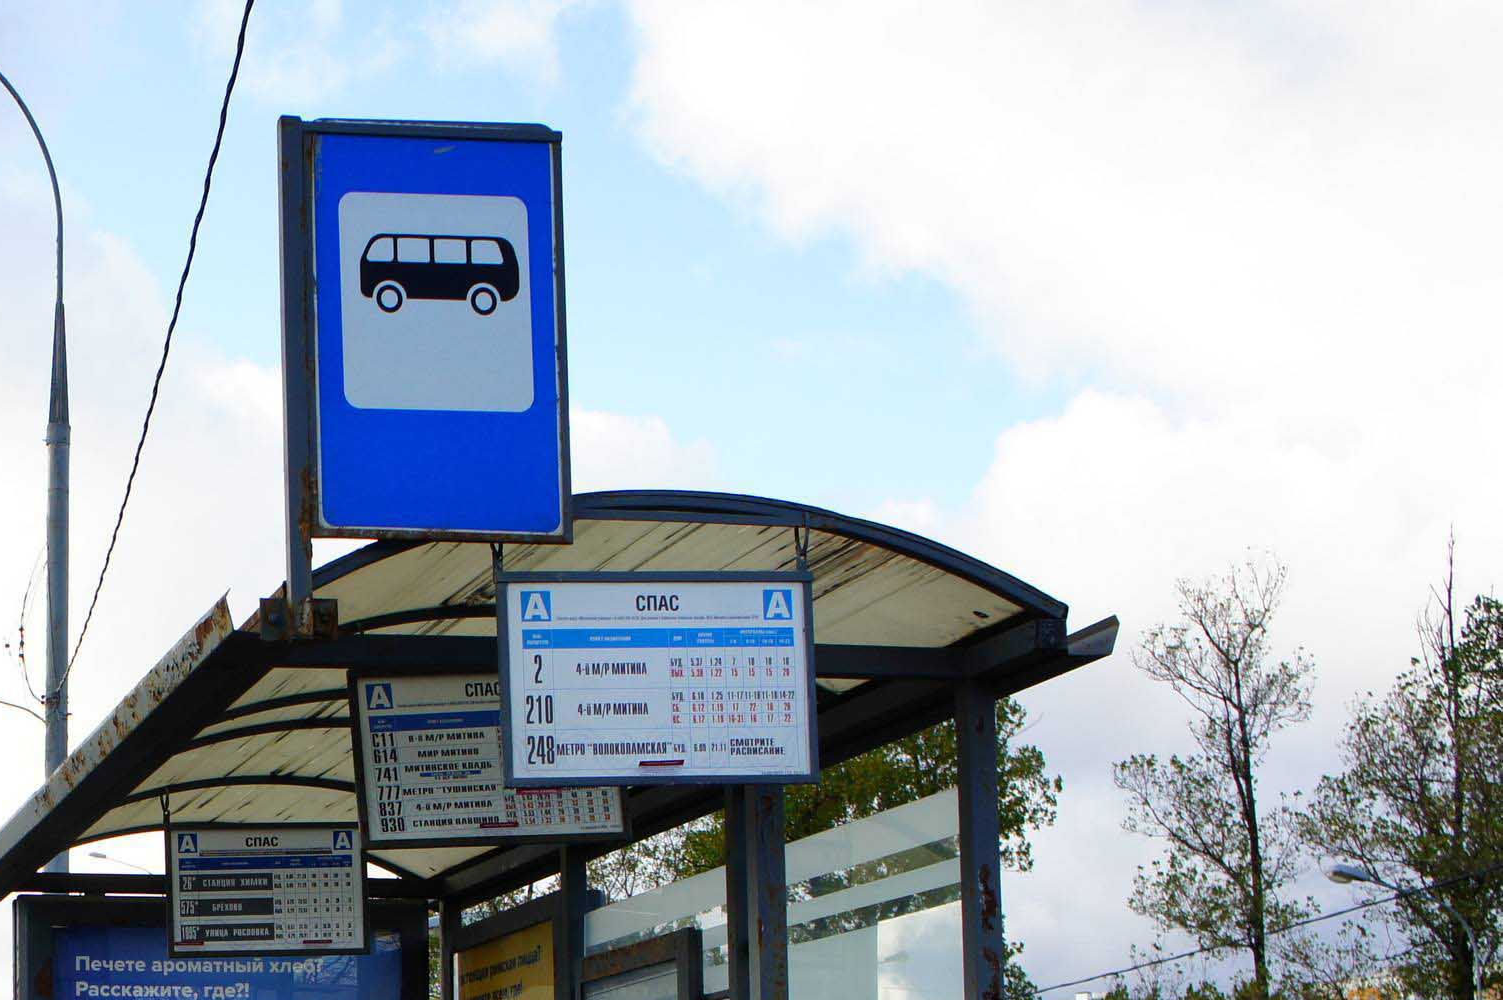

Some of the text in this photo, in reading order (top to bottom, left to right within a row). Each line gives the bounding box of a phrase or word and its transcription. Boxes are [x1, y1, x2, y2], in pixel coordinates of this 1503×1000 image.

[635, 595, 680, 612] СПАС
[534, 654, 543, 685] 2
[592, 662, 610, 679] М/Р
[611, 662, 648, 676] МИТИНА
[525, 695, 554, 725] 210
[593, 703, 611, 719] М/Р
[612, 702, 649, 716] МИТИНА
[374, 748, 398, 764] 614
[527, 735, 556, 765] 248
[556, 743, 586, 757] МЕТРО
[729, 738, 775, 747] СМОТРИТЕ
[730, 746, 786, 756] РАСПИСАНИЕ
[376, 766, 399, 782] 741
[377, 785, 401, 801] 777
[379, 801, 403, 817] 837
[381, 817, 406, 833] 930
[245, 836, 279, 847] СПАС
[75, 954, 146, 973] Печете
[152, 956, 264, 976] ароматный
[75, 980, 250, 1000] Расскажите, где?!
